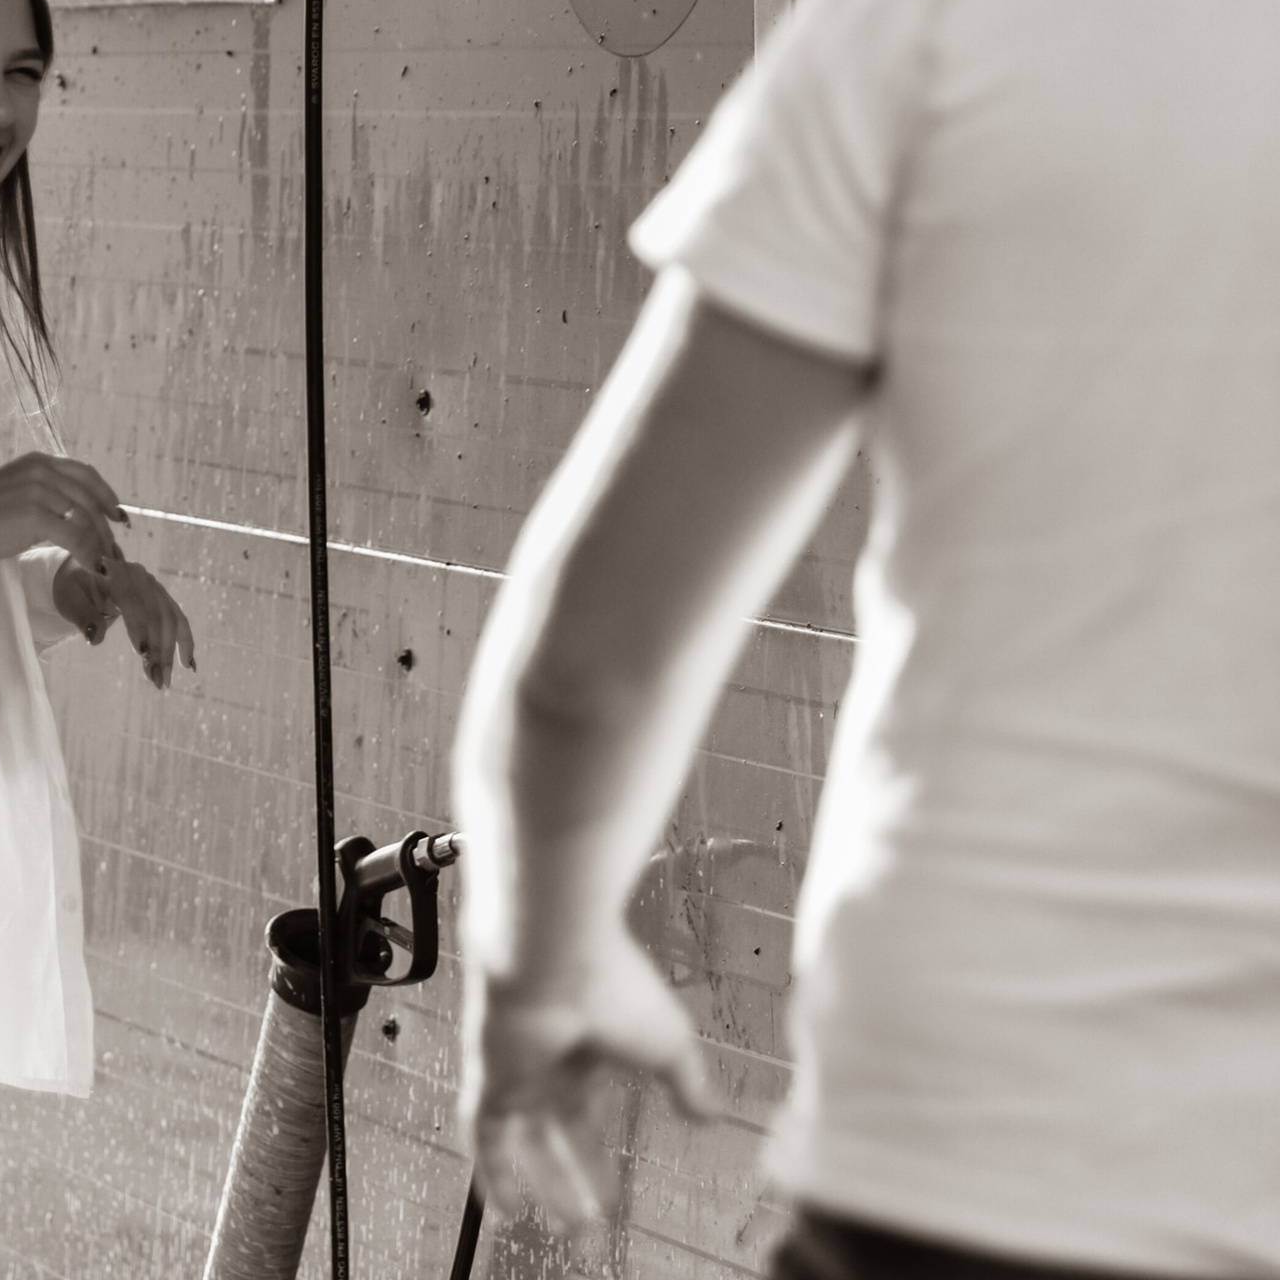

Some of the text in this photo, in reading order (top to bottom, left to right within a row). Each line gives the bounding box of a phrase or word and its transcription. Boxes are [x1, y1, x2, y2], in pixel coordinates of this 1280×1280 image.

[312, 0, 321, 20] 853
[312, 22, 321, 38] EN
[311, 41, 320, 90] SVAROG
